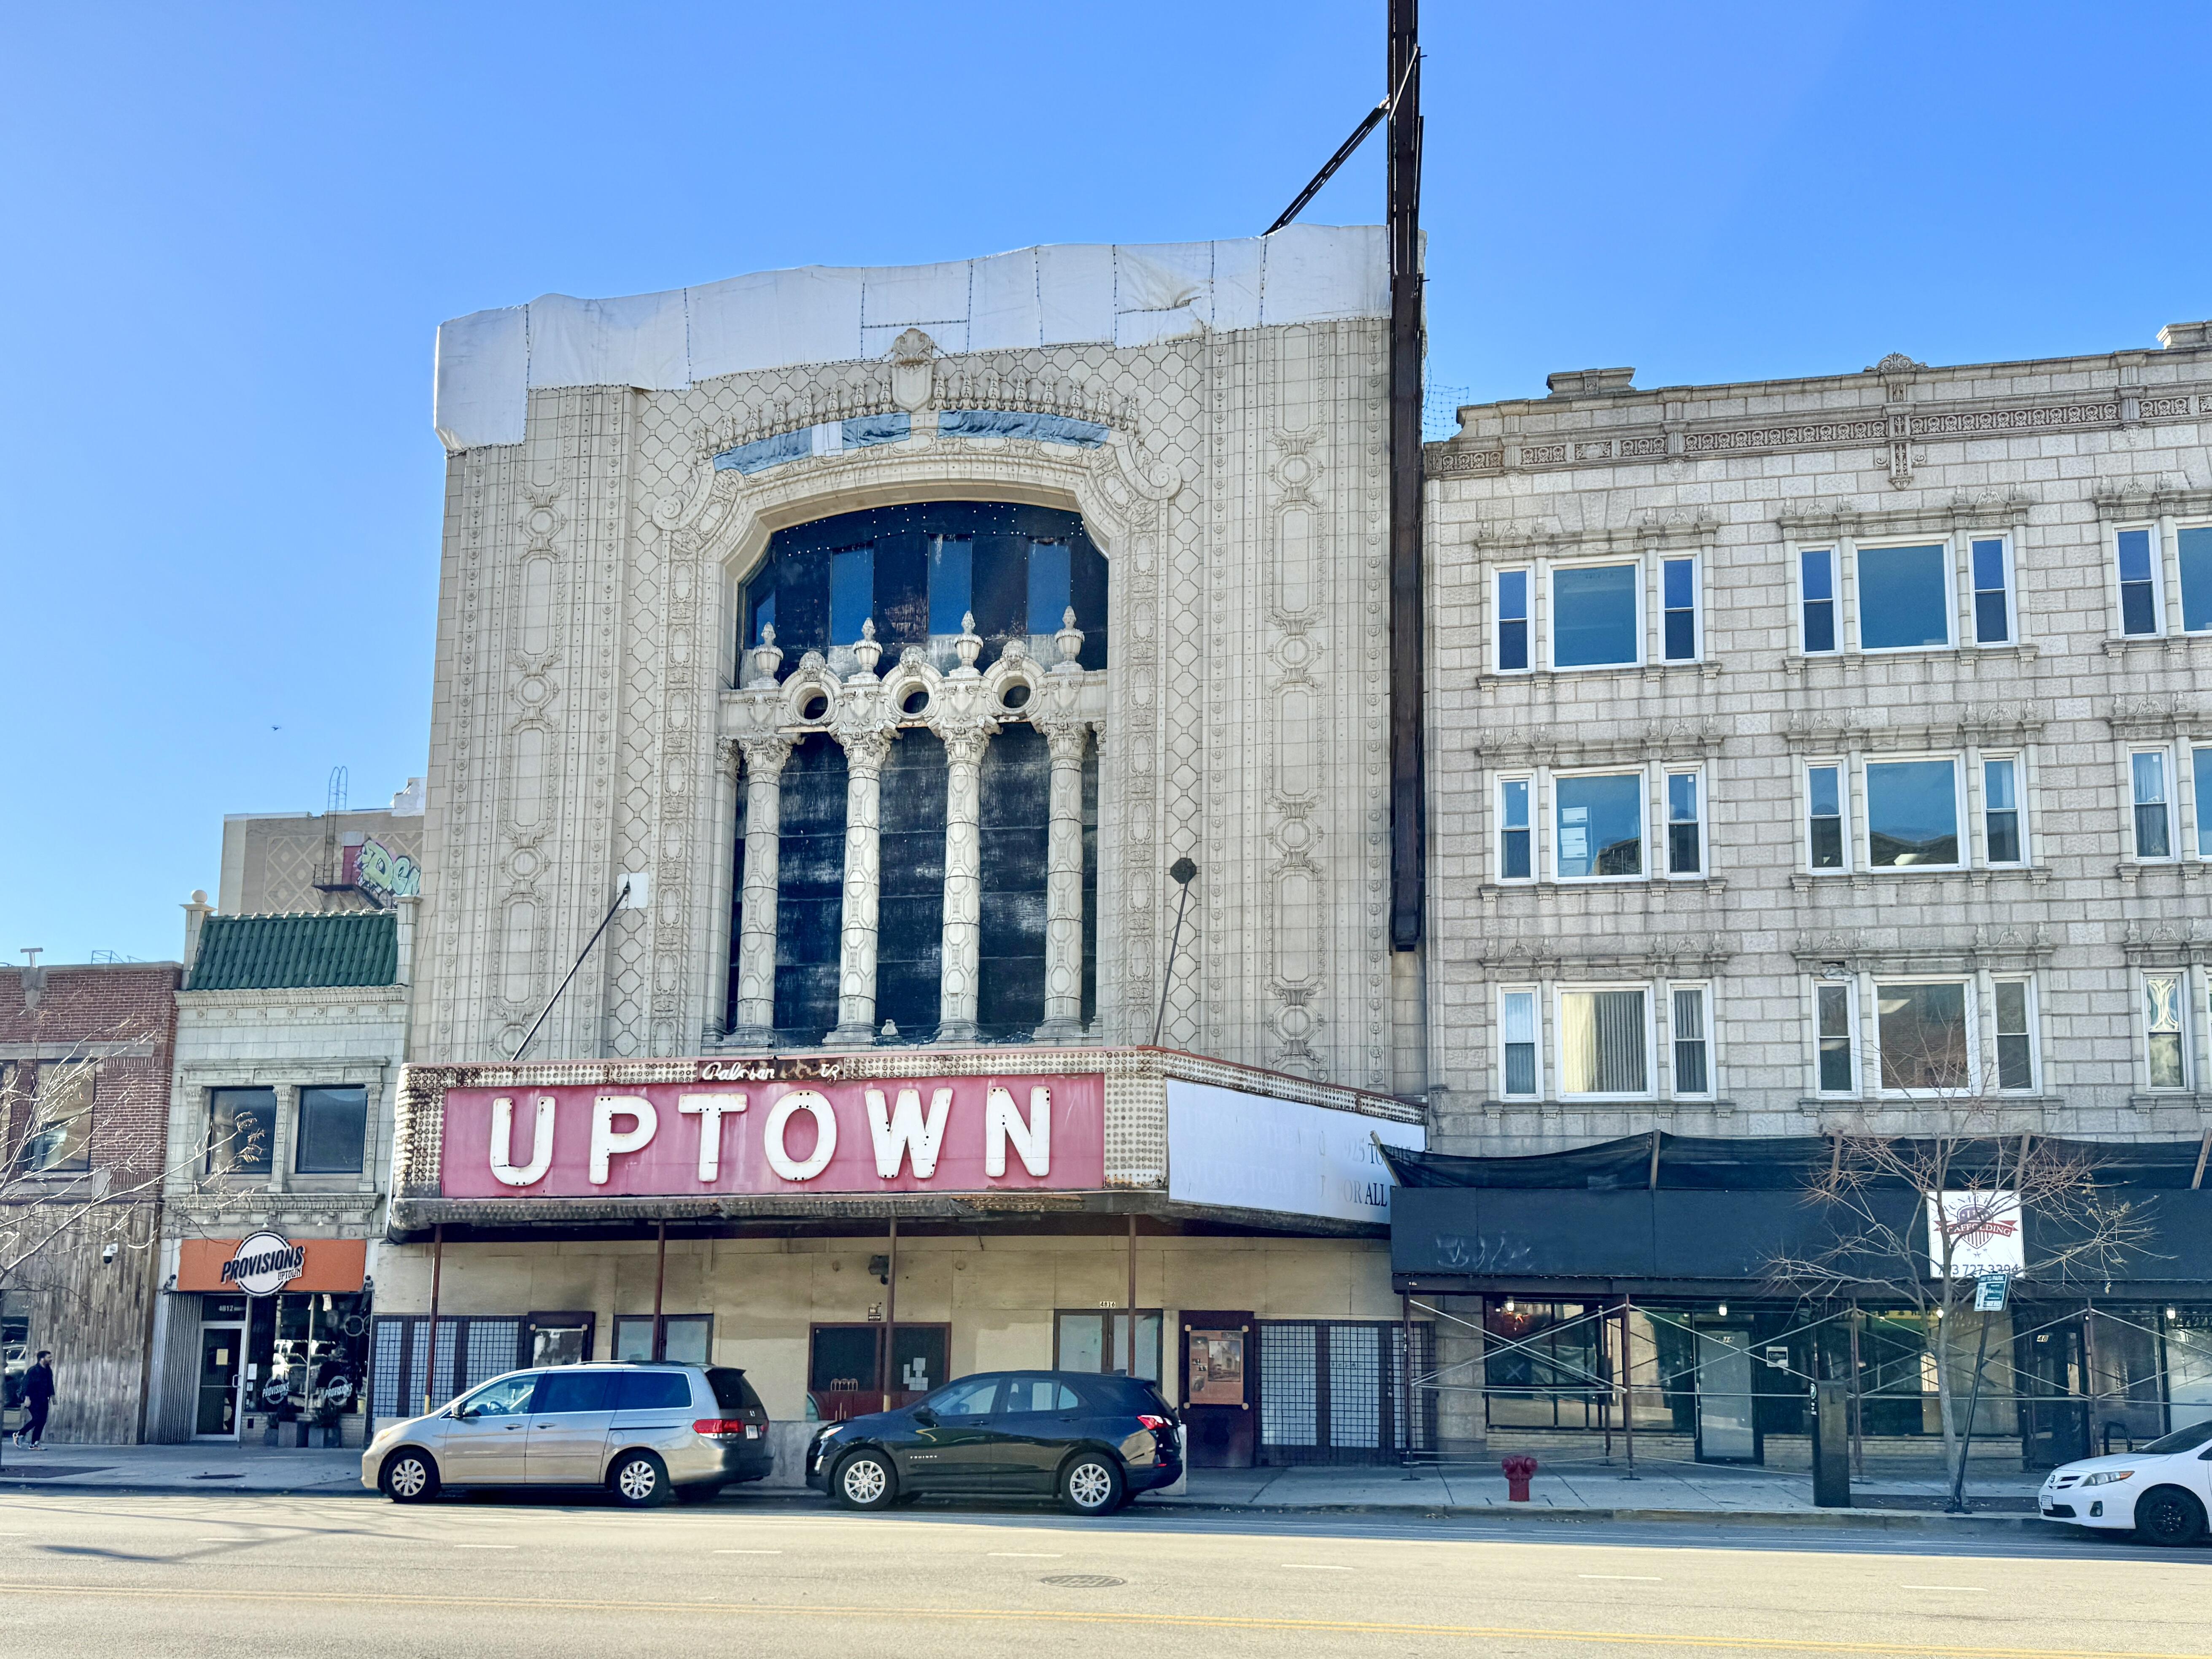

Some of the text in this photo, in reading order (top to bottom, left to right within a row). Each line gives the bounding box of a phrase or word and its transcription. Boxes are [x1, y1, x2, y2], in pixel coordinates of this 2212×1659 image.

[490, 1086, 1051, 1186] UPTOWN
[1365, 1182, 1388, 1207] ALL
[221, 1246, 304, 1282] PROVISIONS
[278, 1268, 302, 1281] UPTOWN
